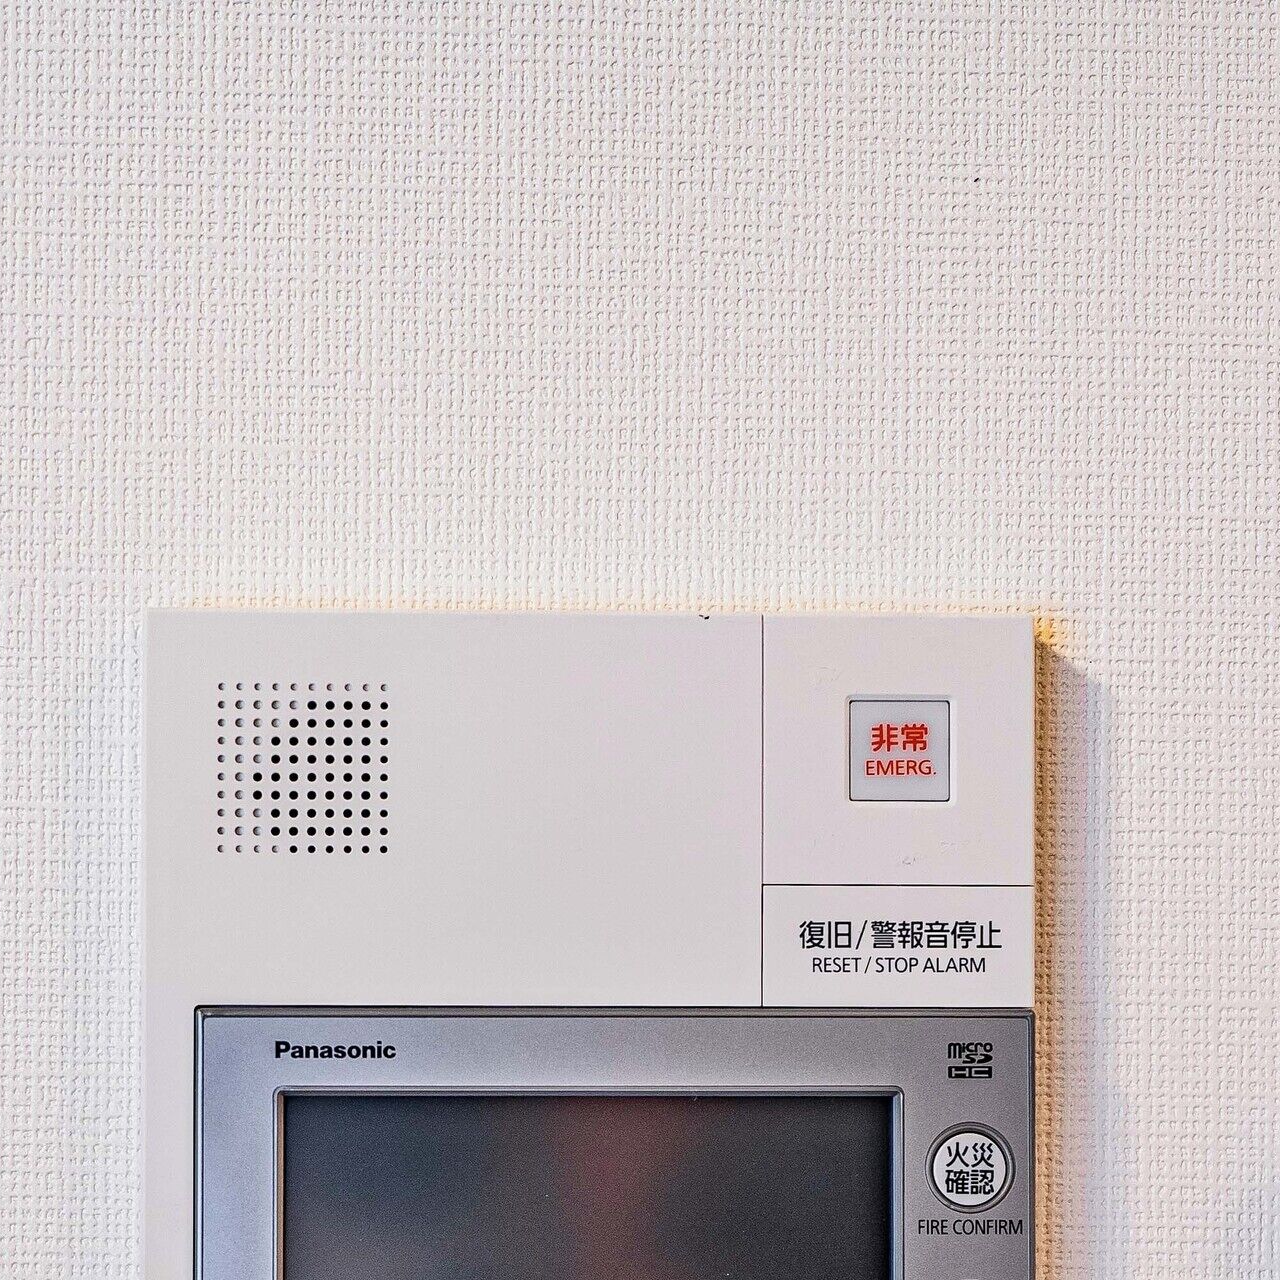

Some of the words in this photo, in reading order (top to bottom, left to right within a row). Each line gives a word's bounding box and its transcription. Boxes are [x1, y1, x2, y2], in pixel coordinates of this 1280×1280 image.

[872, 724, 928, 752] 非常
[866, 760, 937, 776] EMERG.
[800, 920, 1002, 950] 復旧/警報音停止
[813, 957, 861, 972] RESET
[864, 957, 871, 973] /
[876, 958, 918, 973] STOP
[923, 958, 985, 972] ALARM
[275, 1041, 396, 1058] Panasonic
[948, 1042, 993, 1059] micro
[948, 1066, 993, 1079] HC
[918, 1220, 948, 1235] FIRE
[953, 1219, 1023, 1235] CONFIRM
